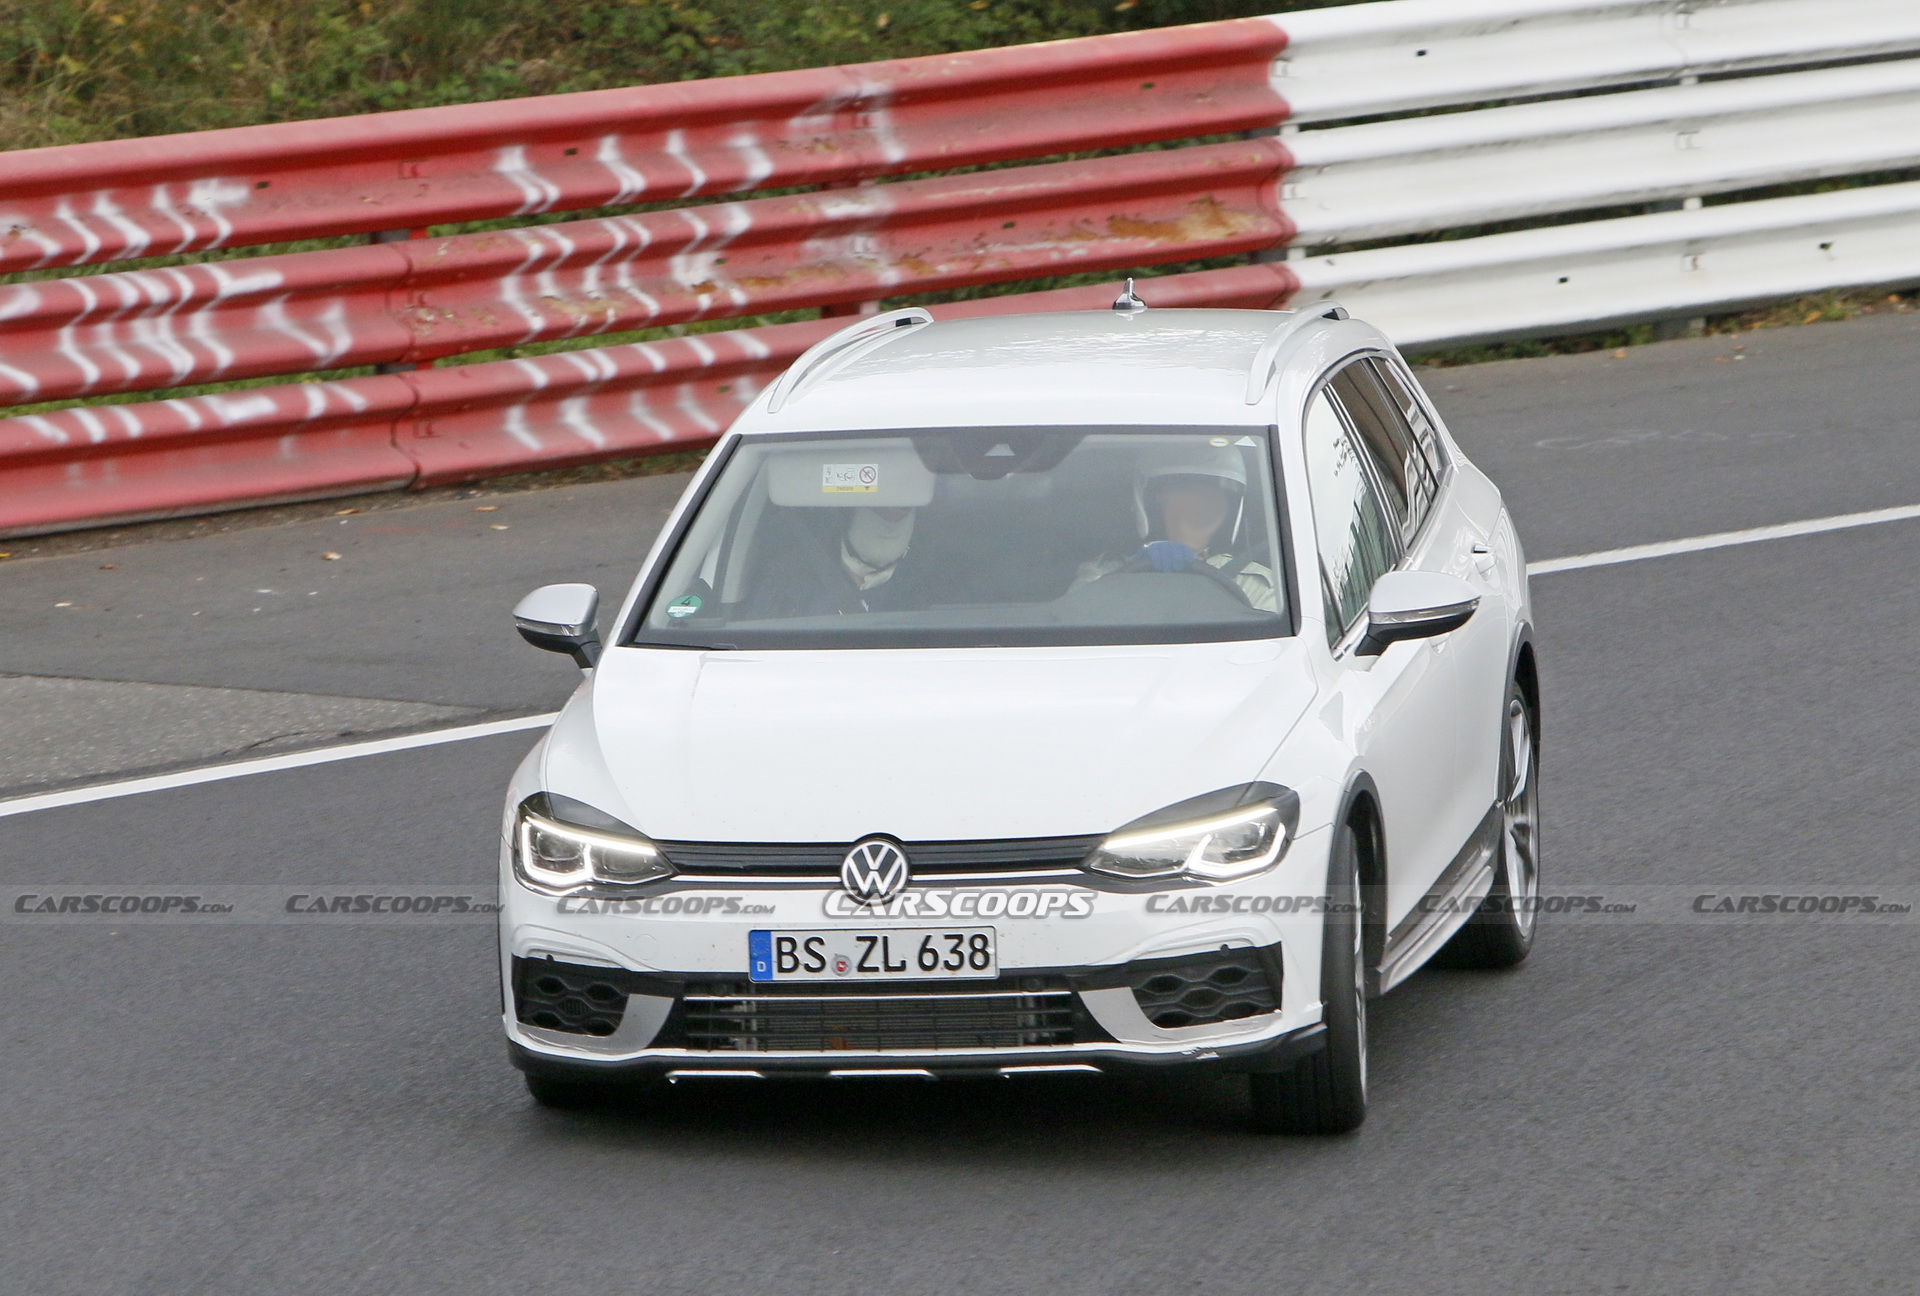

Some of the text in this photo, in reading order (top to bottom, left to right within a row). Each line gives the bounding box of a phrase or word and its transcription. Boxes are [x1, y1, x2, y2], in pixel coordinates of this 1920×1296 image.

[845, 842, 905, 902] VW
[757, 961, 766, 972] D
[776, 933, 990, 973] BS ZL 638
